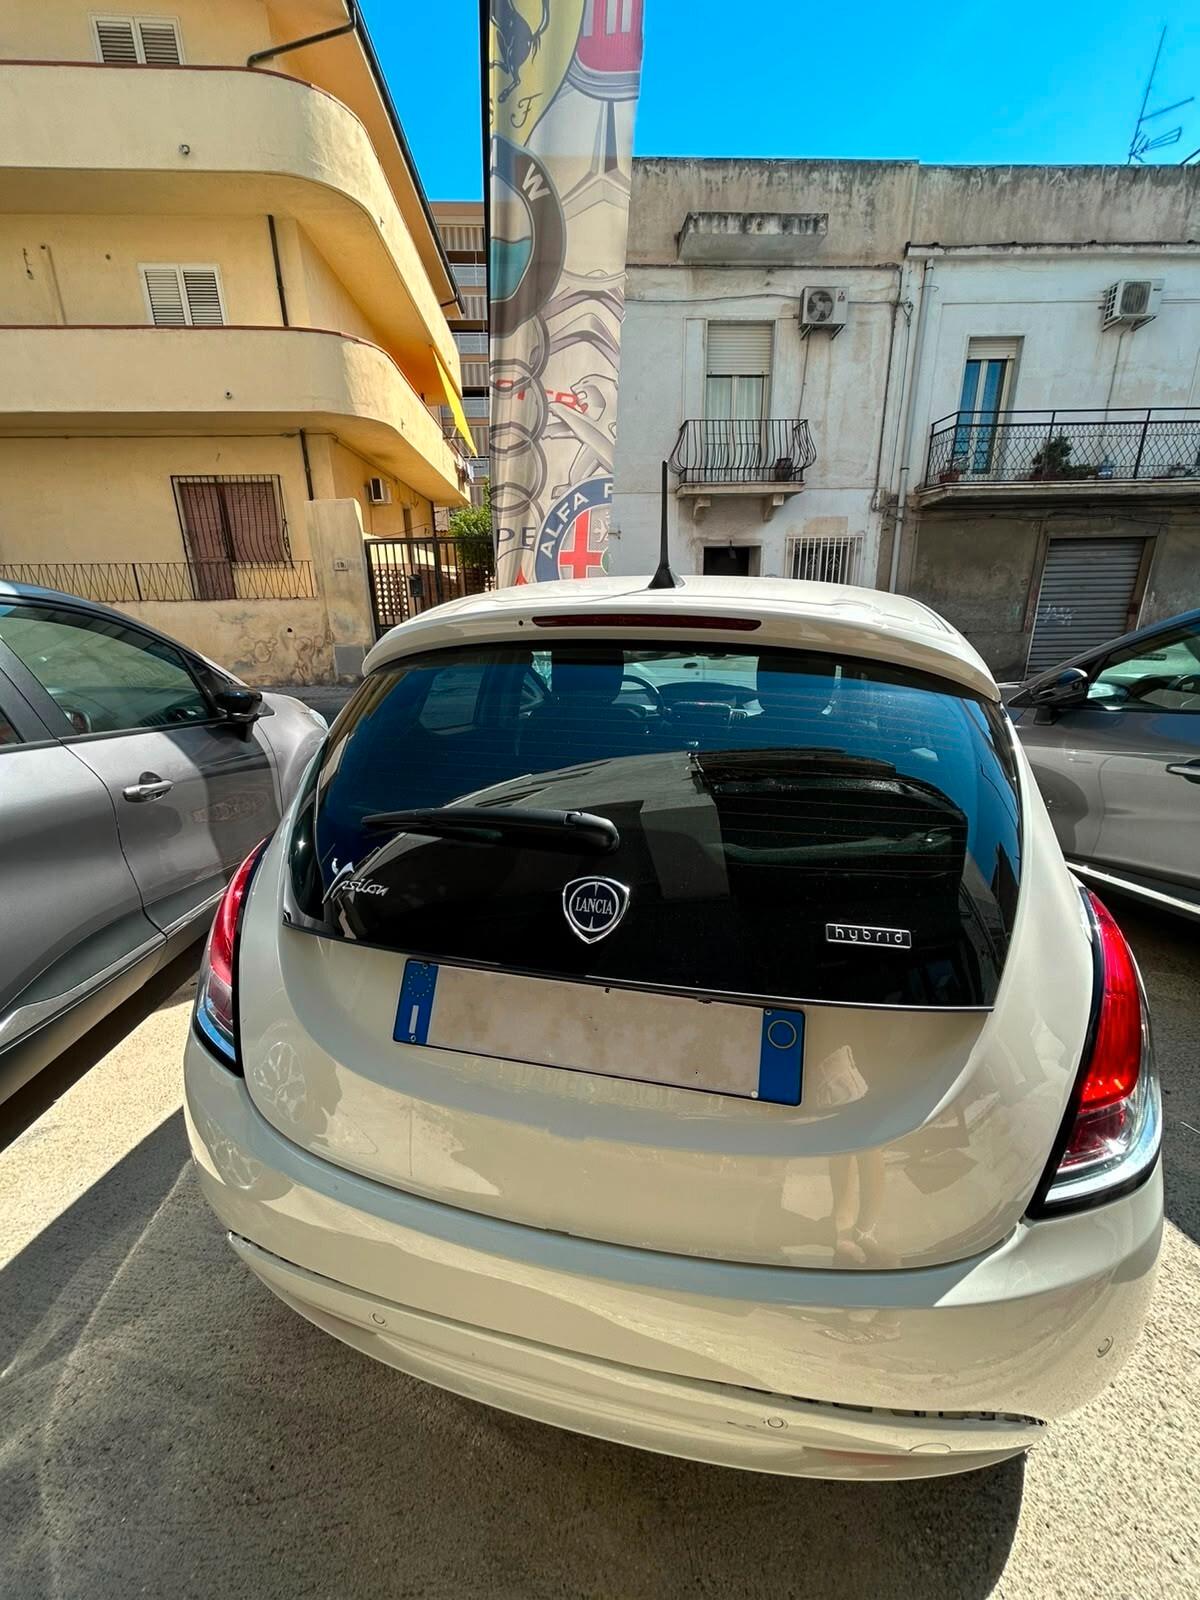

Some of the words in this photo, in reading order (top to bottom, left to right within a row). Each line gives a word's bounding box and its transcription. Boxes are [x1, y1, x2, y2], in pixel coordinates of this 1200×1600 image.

[540, 492, 589, 559] ALFA
[321, 857, 389, 904] Ypsilon
[575, 896, 613, 915] LANCIA
[835, 926, 903, 943] hybrid
